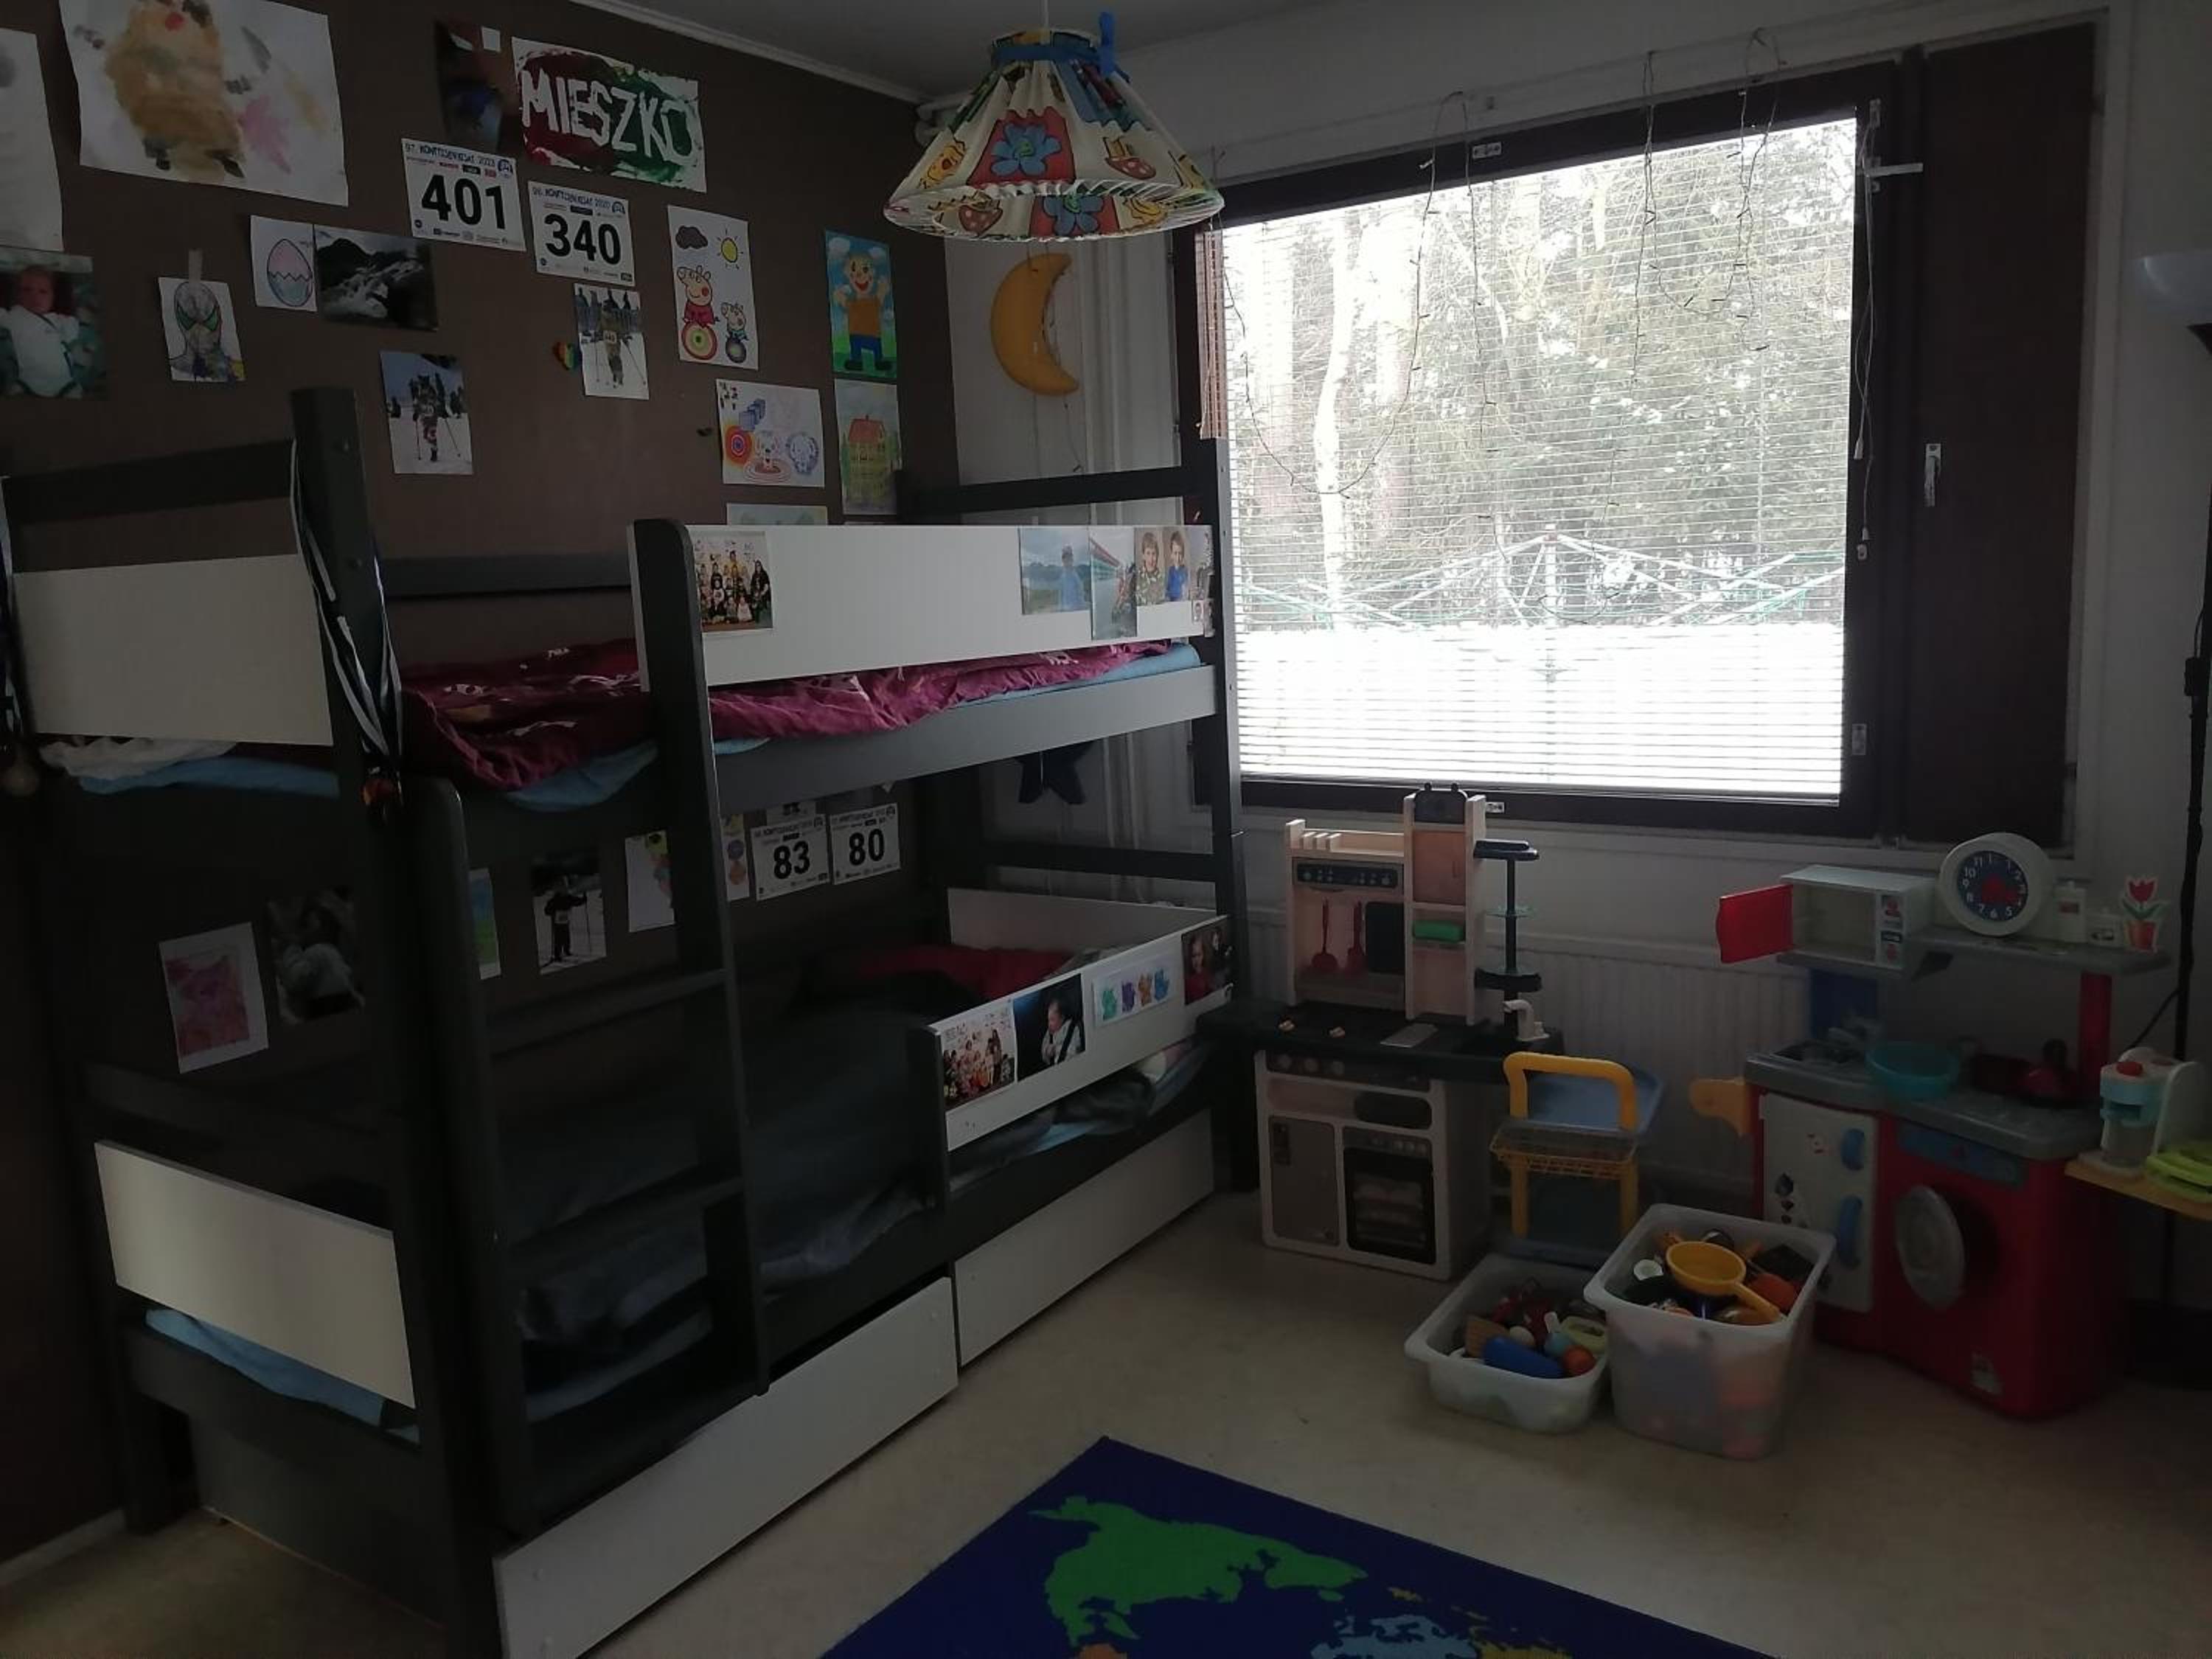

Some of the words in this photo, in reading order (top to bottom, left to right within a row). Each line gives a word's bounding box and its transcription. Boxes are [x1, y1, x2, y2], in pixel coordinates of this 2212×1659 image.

[520, 68, 694, 161] MIESZKO
[422, 175, 505, 229] 401
[545, 214, 621, 265] 340
[774, 841, 810, 878] 83
[849, 830, 885, 865] 80
[1964, 866, 1977, 878] 10
